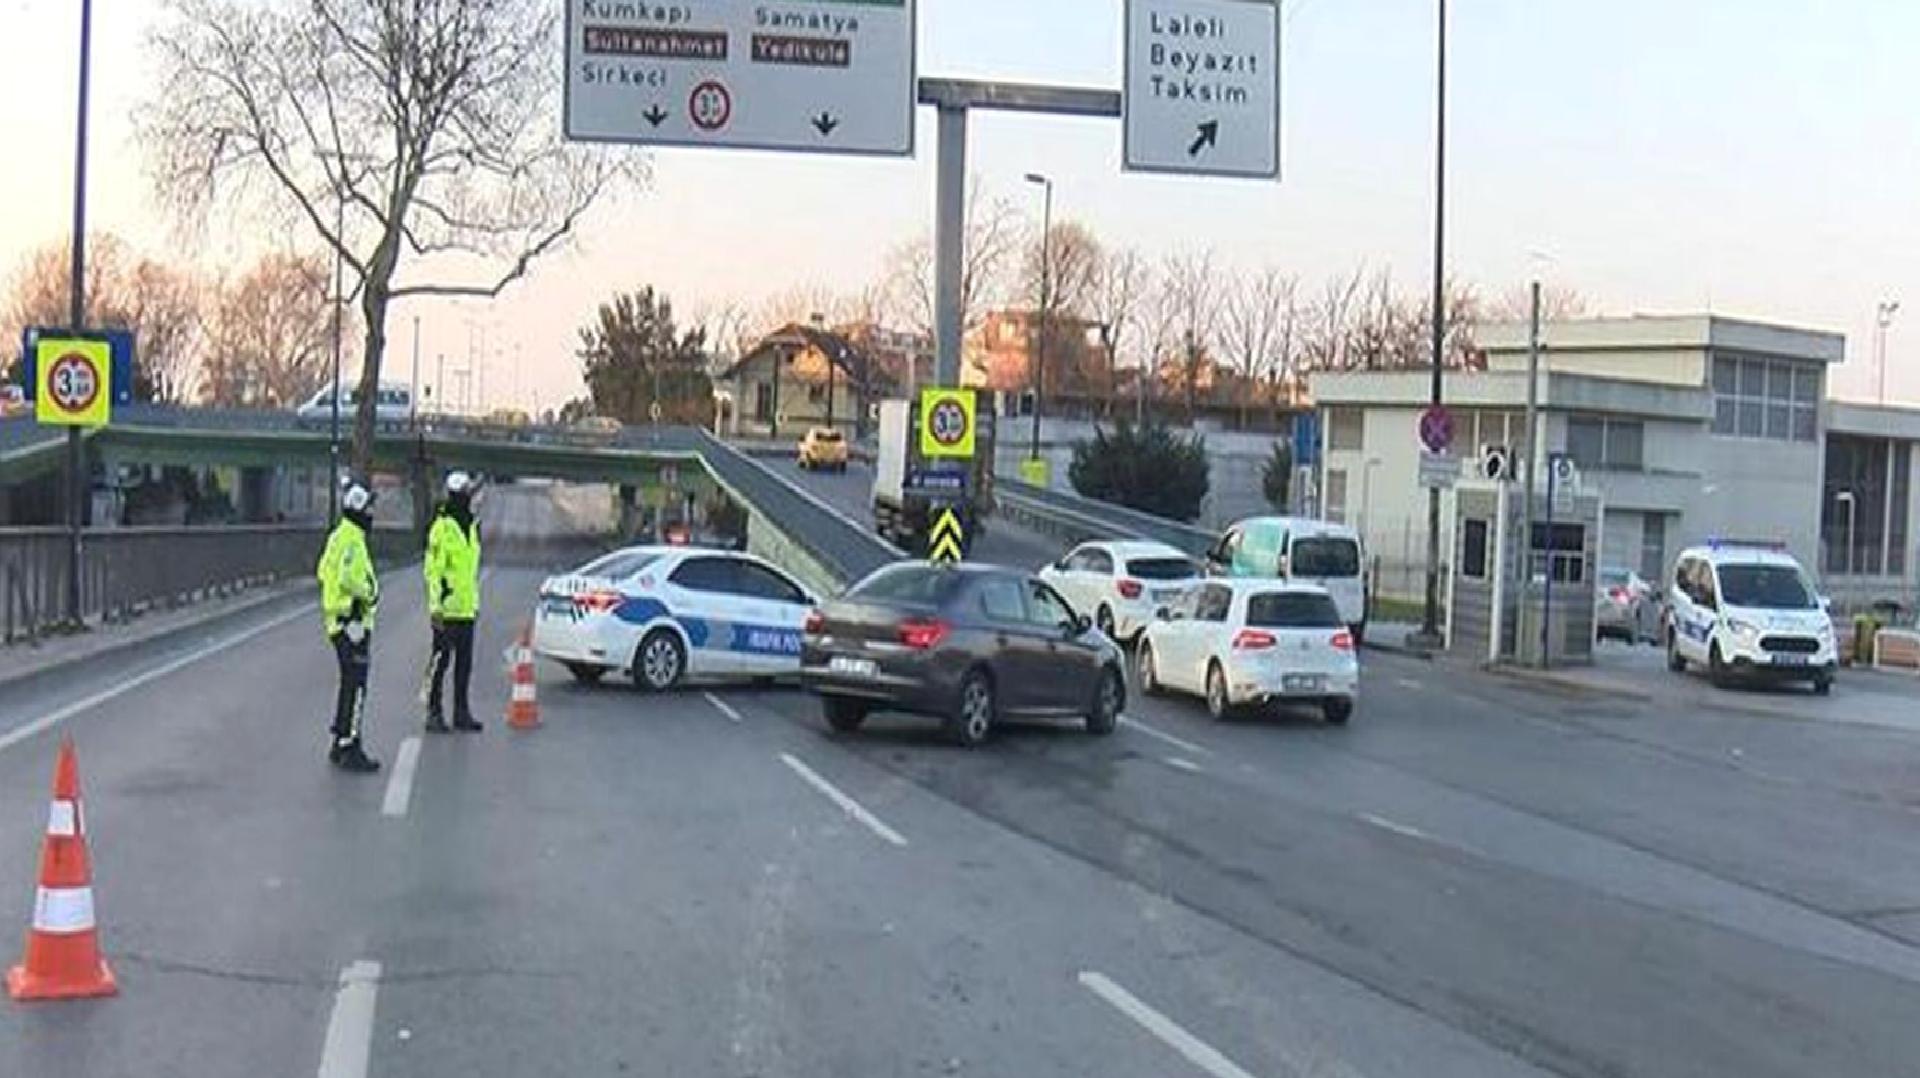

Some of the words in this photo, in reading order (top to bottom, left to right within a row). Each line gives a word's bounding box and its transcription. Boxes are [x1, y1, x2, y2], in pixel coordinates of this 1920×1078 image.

[757, 7, 858, 34] Samatya
[1151, 11, 1223, 37] Laleli
[582, 61, 666, 86] Sirkeci
[1151, 75, 1246, 102] Taksim
